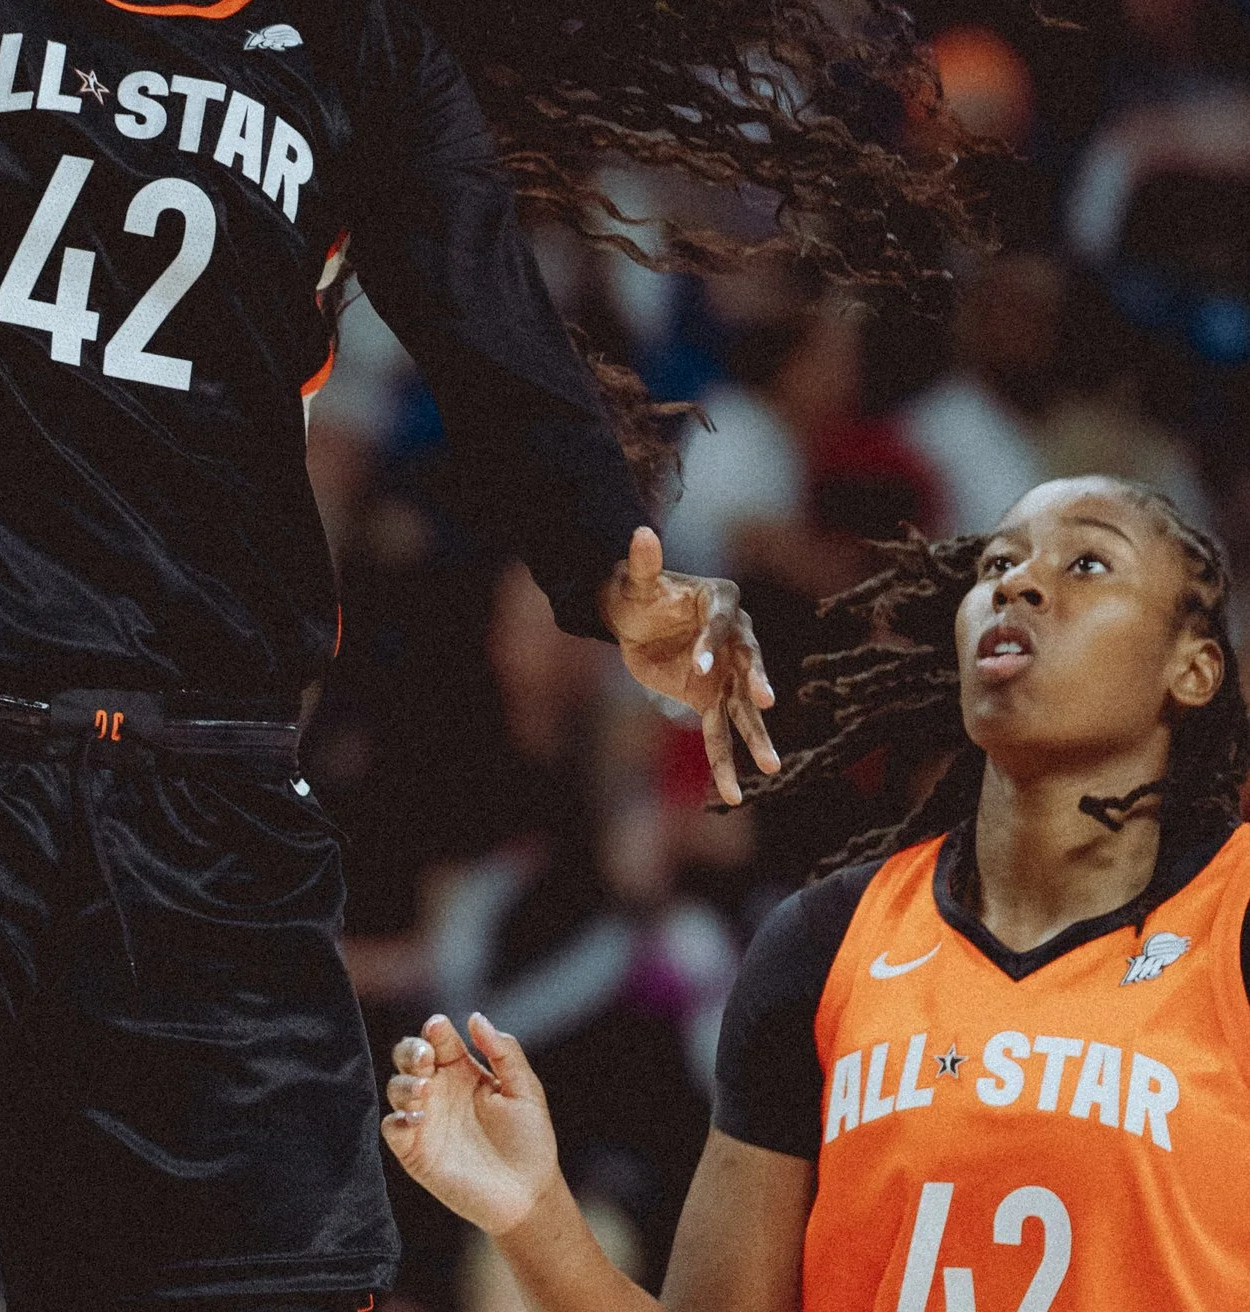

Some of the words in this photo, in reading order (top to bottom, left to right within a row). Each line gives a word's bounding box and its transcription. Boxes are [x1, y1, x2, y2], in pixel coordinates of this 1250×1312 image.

[114, 70, 315, 224] STAR
[825, 1032, 935, 1145] ALL
[975, 1030, 1181, 1153] STAR
